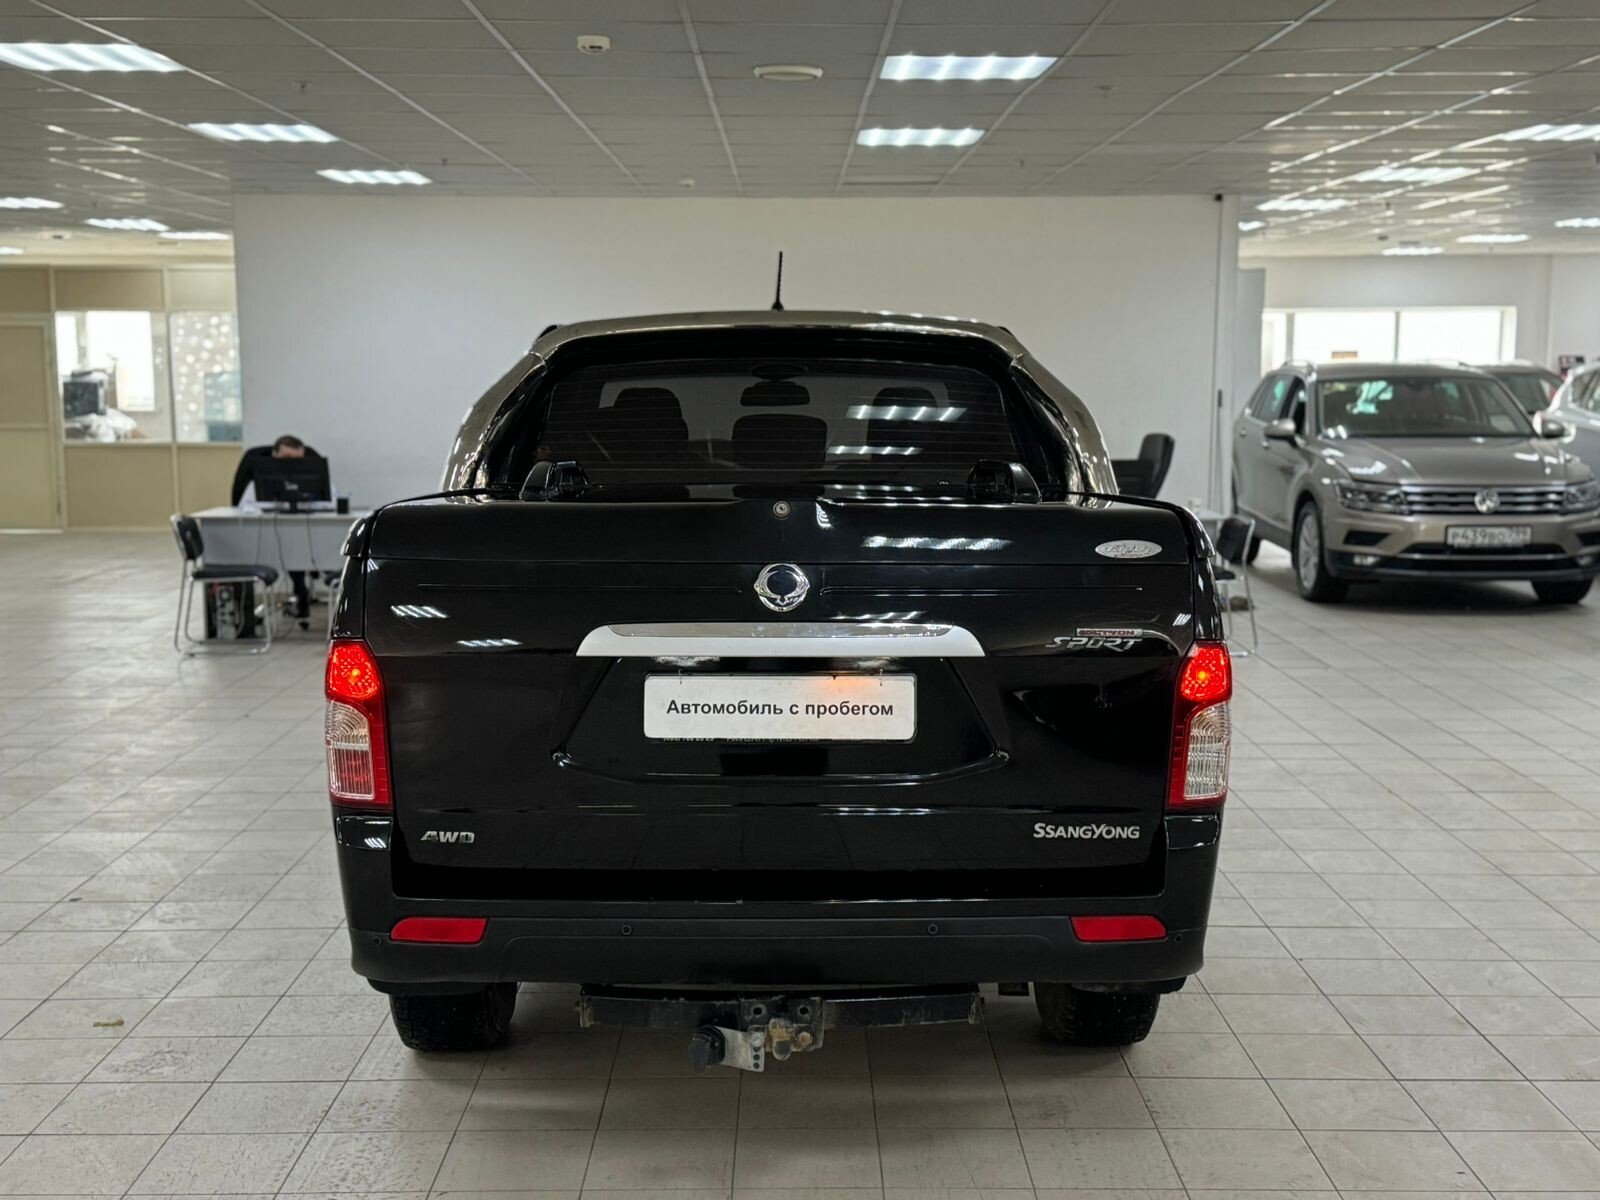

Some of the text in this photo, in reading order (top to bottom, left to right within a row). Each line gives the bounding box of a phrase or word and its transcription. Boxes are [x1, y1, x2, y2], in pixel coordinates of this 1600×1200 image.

[1045, 636, 1143, 652] SPORT
[666, 699, 894, 719] Автомобиль с пробегом
[420, 830, 475, 843] AWD
[1033, 822, 1140, 839] SSANGYONG
